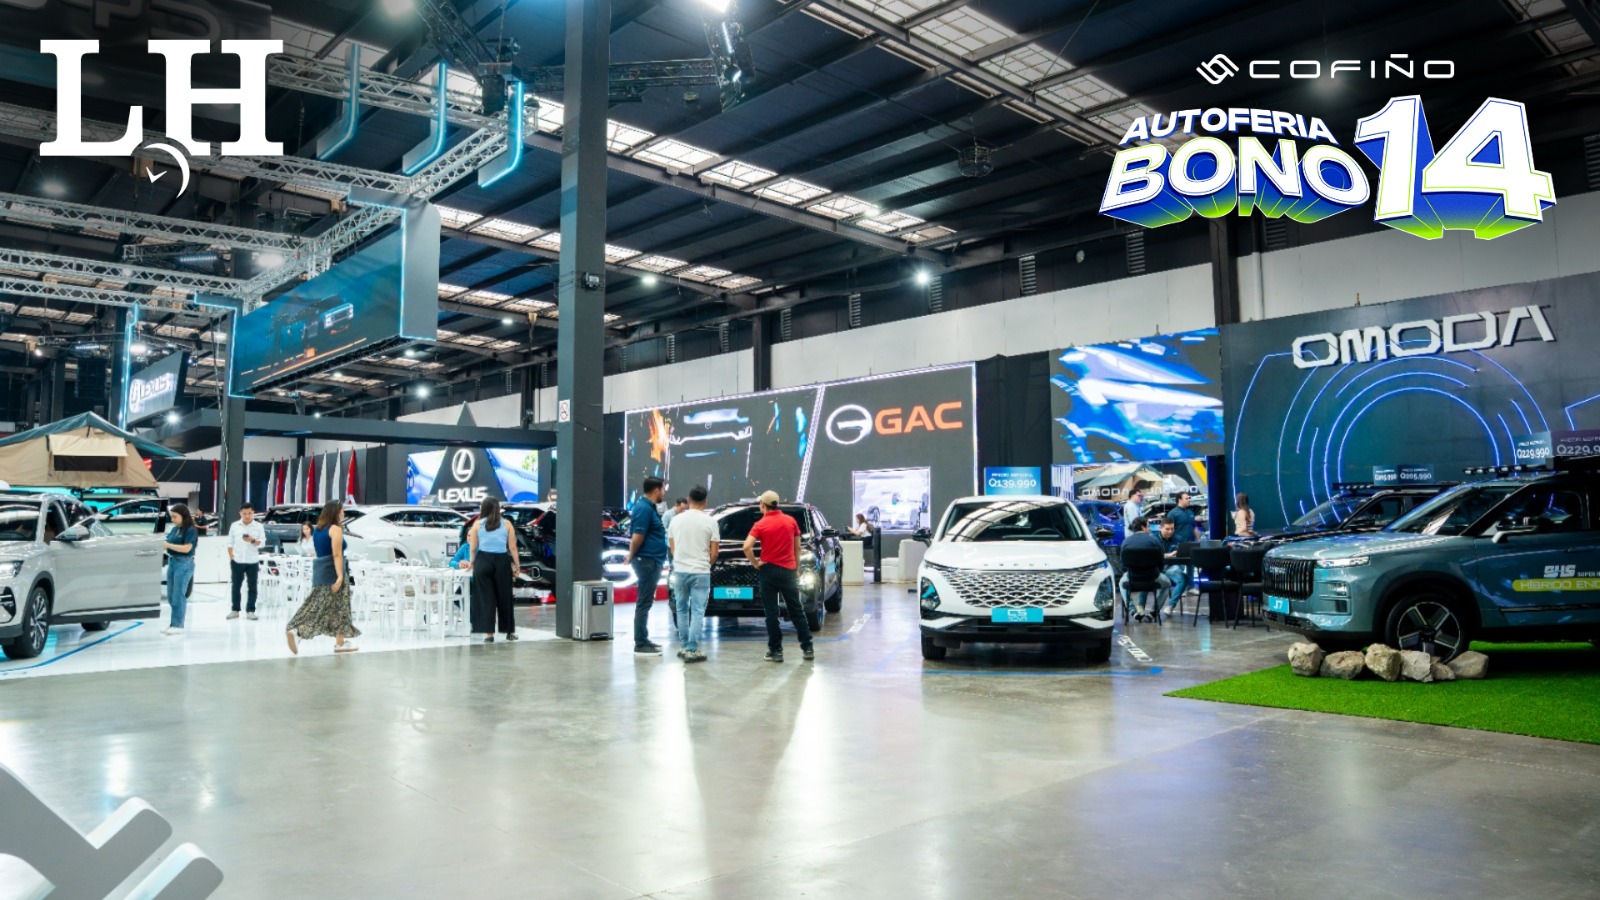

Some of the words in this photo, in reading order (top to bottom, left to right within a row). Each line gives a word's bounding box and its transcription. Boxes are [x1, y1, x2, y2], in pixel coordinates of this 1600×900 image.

[1292, 304, 1556, 370] OMODA
[140, 373, 171, 399] LEXUS
[875, 401, 963, 436] GAC
[437, 486, 488, 504] LEXUS
